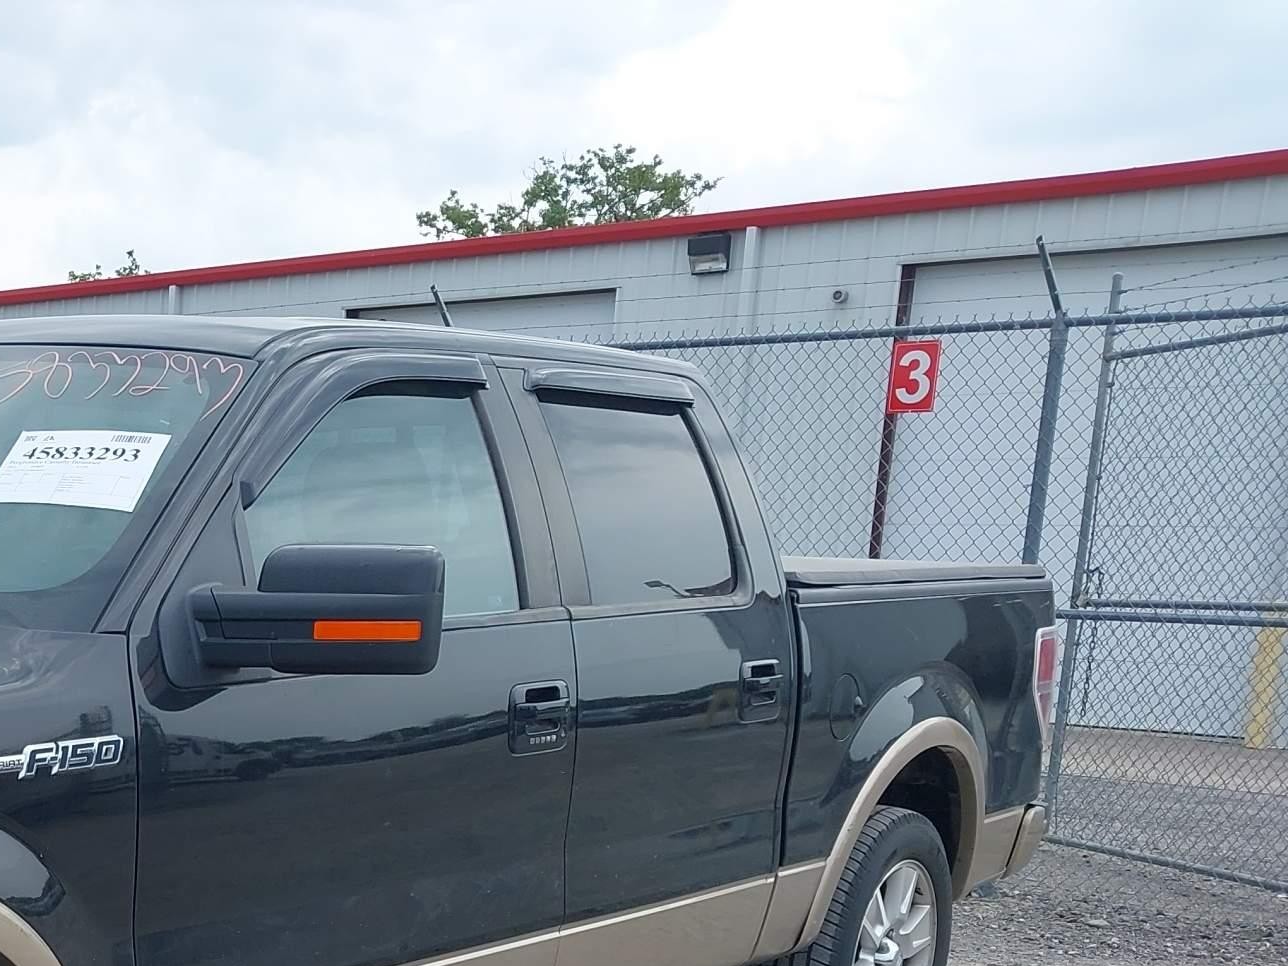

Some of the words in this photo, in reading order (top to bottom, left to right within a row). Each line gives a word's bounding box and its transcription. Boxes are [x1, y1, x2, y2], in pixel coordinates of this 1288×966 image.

[895, 350, 931, 404] 3
[23, 446, 142, 462] 45833293
[18, 735, 124, 780] F-150
